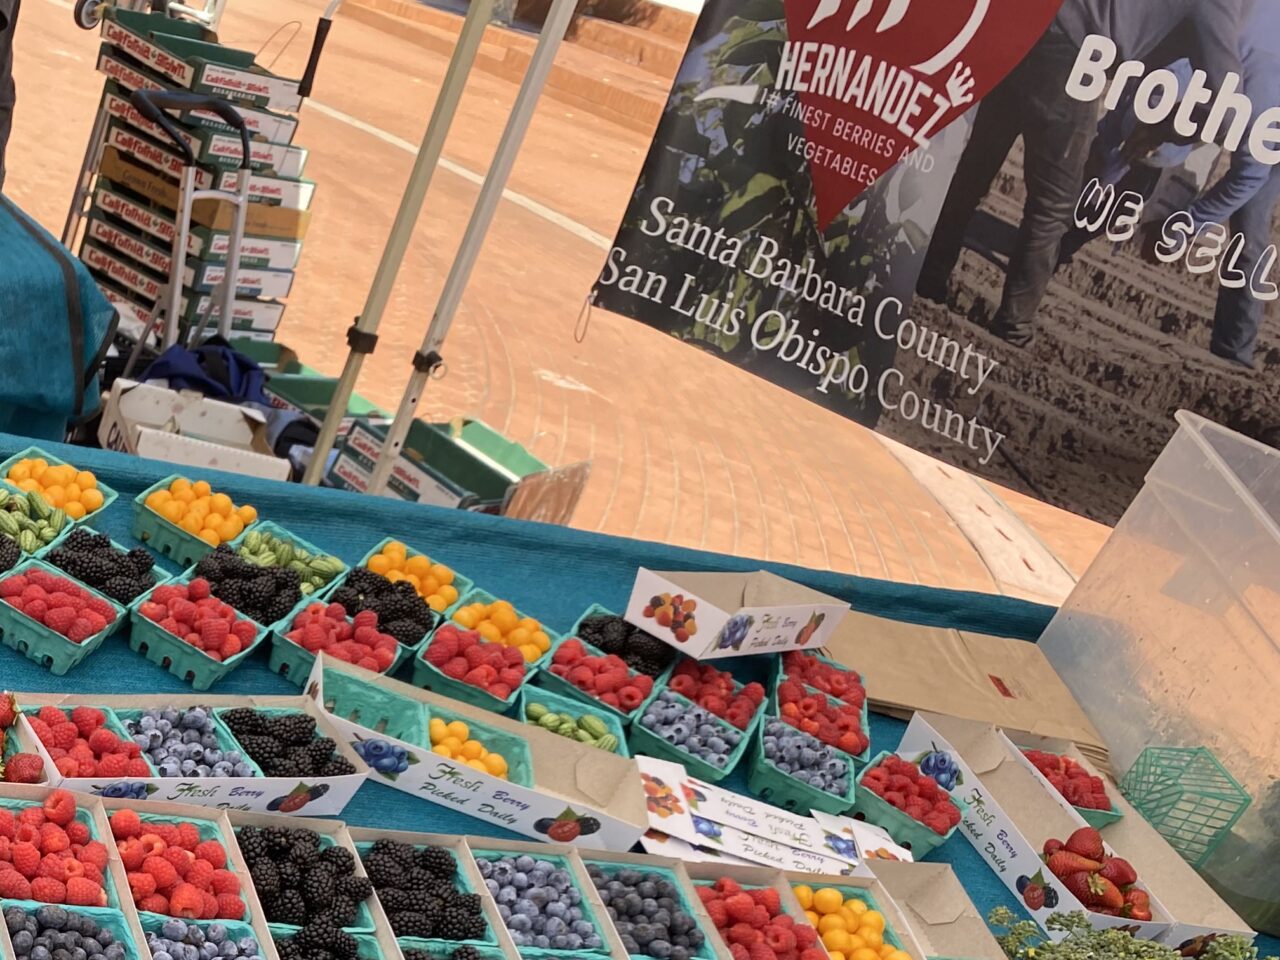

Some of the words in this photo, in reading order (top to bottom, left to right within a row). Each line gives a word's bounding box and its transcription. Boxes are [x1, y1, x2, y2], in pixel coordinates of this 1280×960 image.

[775, 41, 951, 150] HERNANDEZ
[1065, 34, 1280, 165] Brothe
[783, 93, 832, 131] FINEST
[832, 117, 896, 159] BERRIES
[897, 146, 935, 173] AND
[787, 132, 879, 186] VEGETABLES
[1074, 178, 1144, 241] WE
[1155, 211, 1279, 300] SELL
[640, 197, 743, 268] Santa
[744, 235, 866, 327] Barbara
[874, 296, 999, 395] County
[600, 246, 669, 304] San
[670, 273, 746, 336] Luis
[750, 309, 869, 393] Obispo
[877, 368, 1006, 465] County
[167, 783, 221, 800] Fresh
[228, 786, 265, 799] Berry
[419, 782, 470, 805] Picked
[477, 803, 520, 825] Daily
[428, 763, 484, 793] Fresh
[492, 790, 531, 811] Berry
[962, 817, 983, 840] icked
[984, 841, 1008, 874] Daily
[964, 788, 996, 827] Fresh
[996, 829, 1019, 859] Berry
[792, 860, 825, 875] Dail
